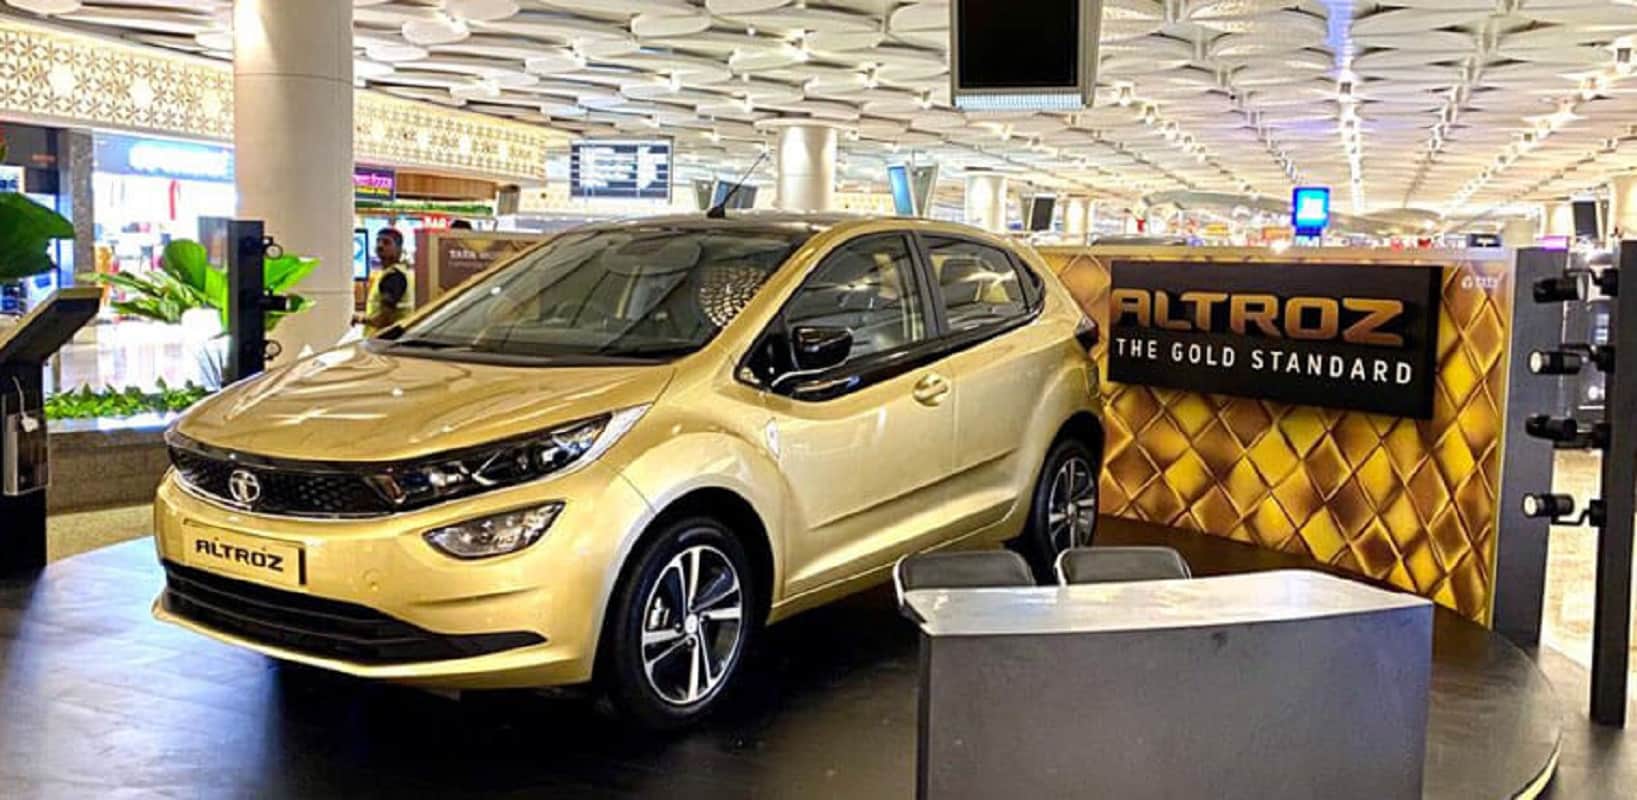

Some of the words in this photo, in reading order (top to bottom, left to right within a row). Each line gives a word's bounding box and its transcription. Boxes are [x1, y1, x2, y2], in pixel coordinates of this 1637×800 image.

[1110, 288, 1404, 347] ALTROZ
[1115, 337, 1158, 360] THE
[1171, 341, 1236, 368] GOLD
[1251, 349, 1413, 385] STANDARD
[195, 538, 284, 573] ALTROZ
